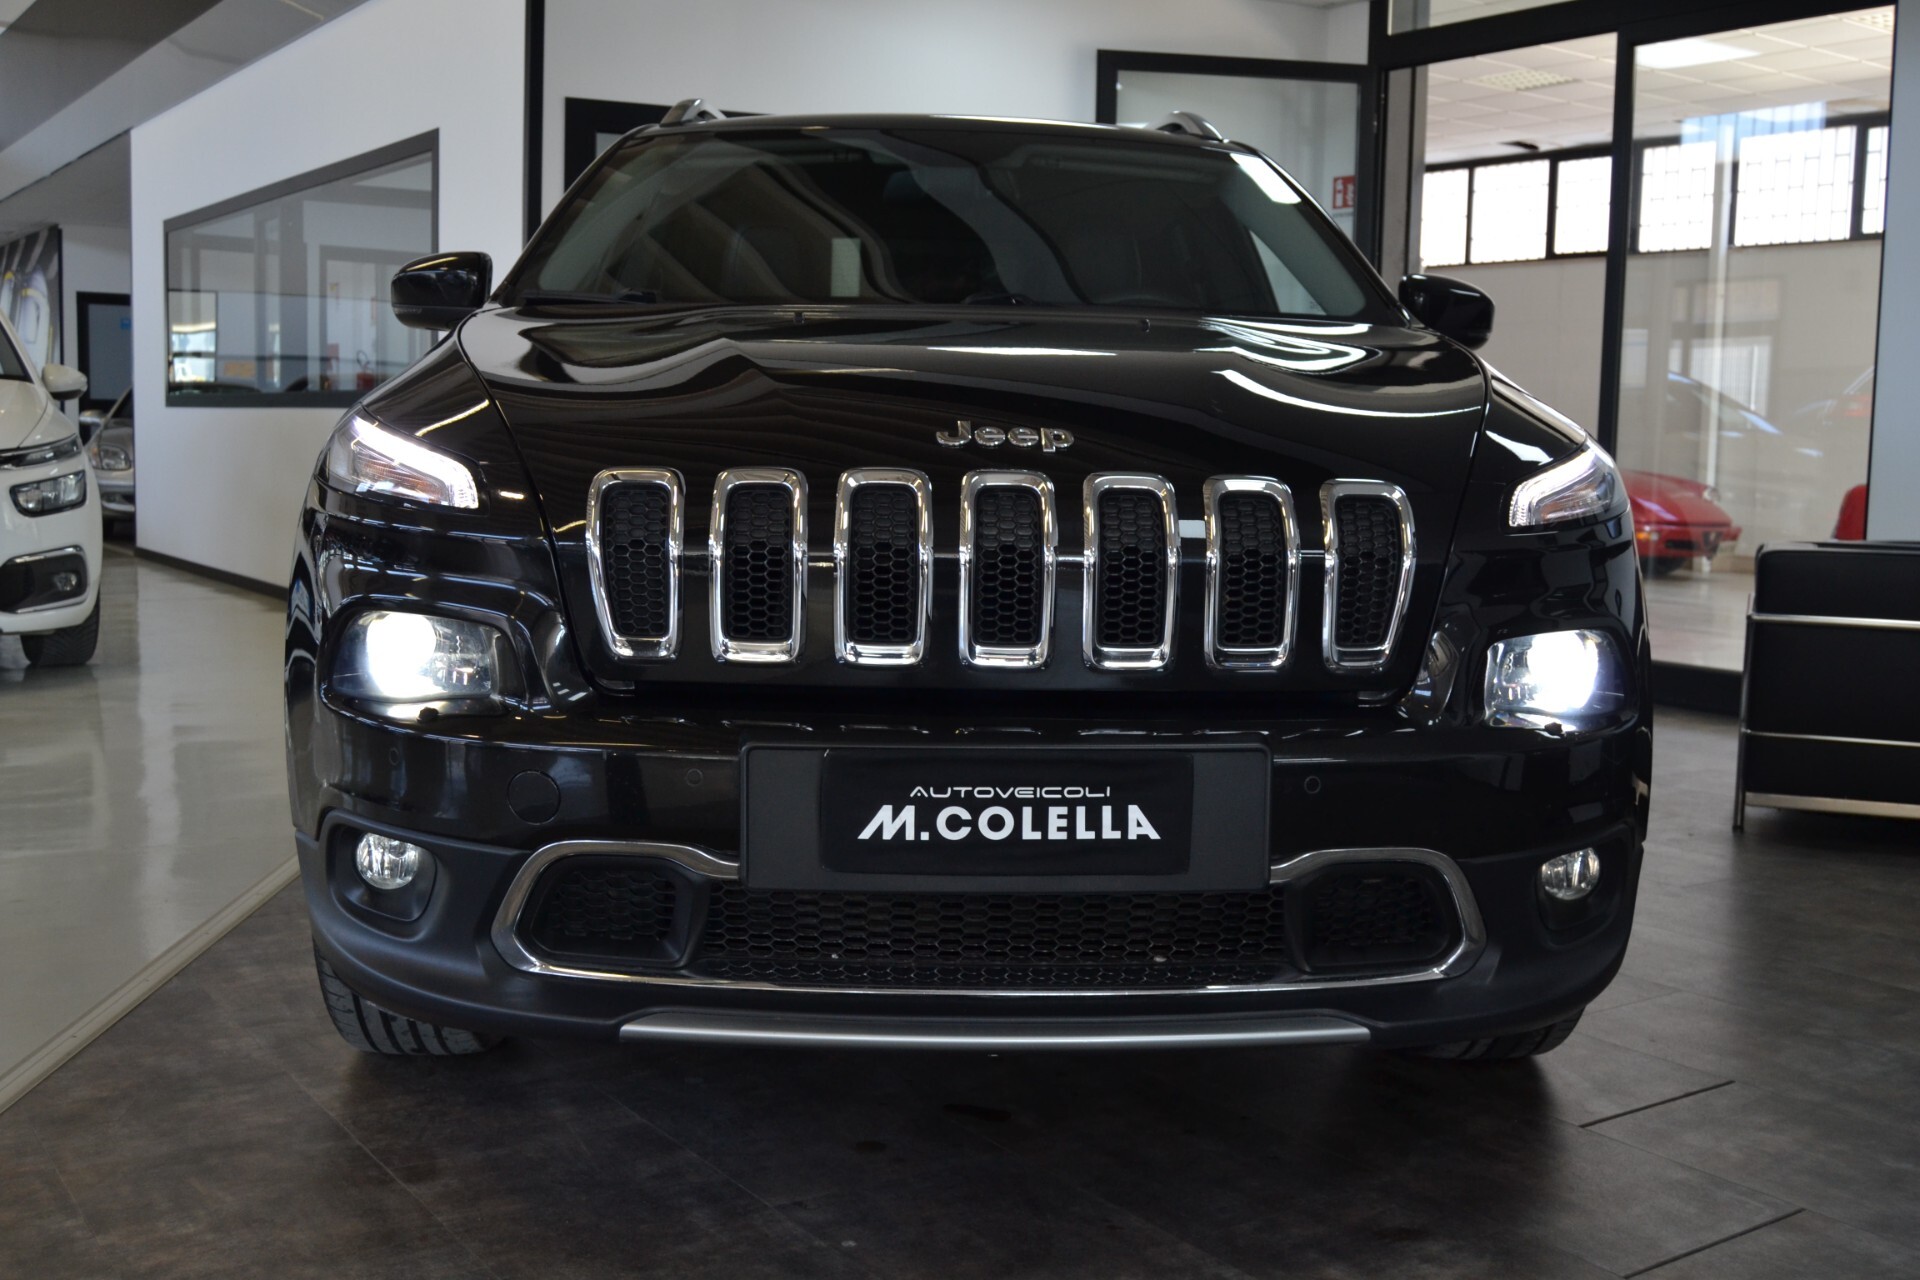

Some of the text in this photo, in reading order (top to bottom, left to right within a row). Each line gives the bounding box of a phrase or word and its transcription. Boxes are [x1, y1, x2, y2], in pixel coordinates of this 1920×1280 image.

[936, 420, 1075, 453] Jeep
[909, 785, 1112, 799] AUTOVEICOLI
[857, 804, 1162, 841] M.COLELLA
